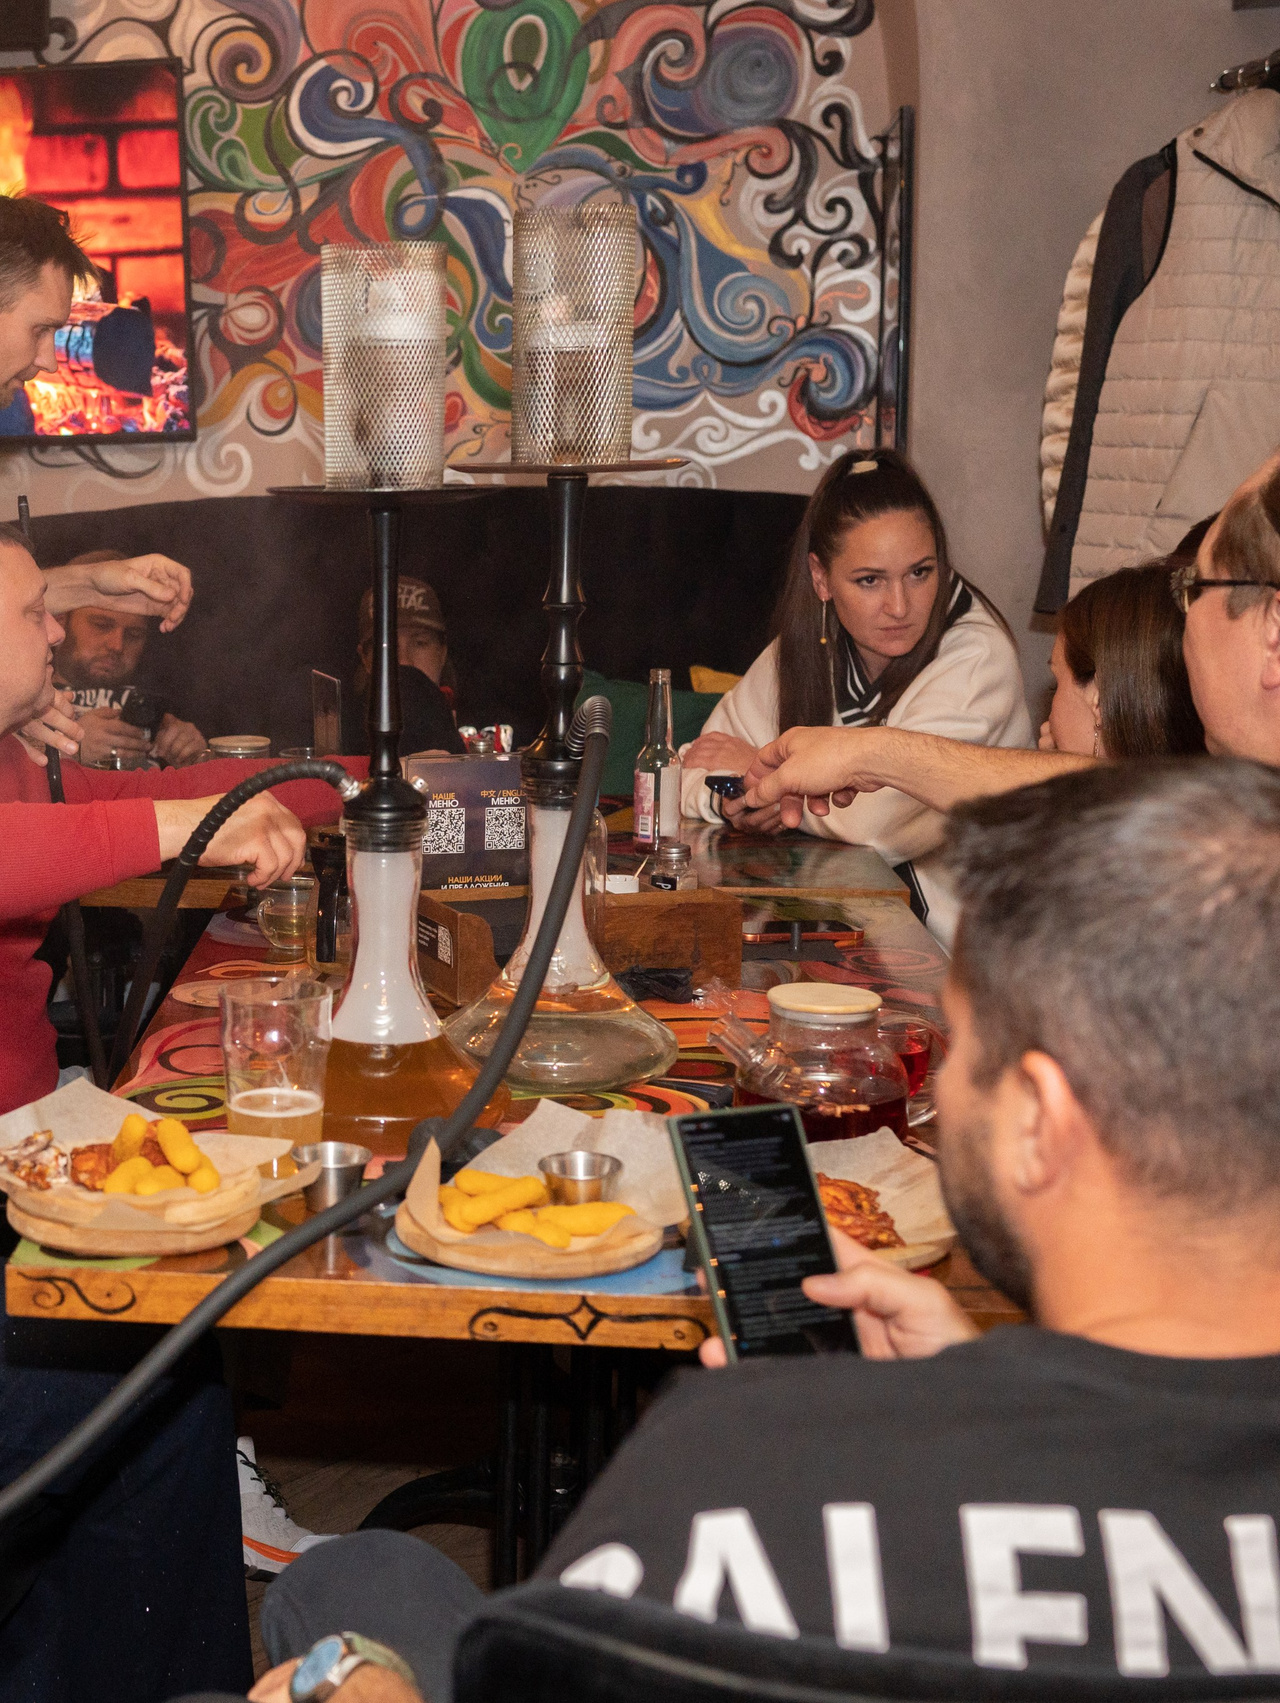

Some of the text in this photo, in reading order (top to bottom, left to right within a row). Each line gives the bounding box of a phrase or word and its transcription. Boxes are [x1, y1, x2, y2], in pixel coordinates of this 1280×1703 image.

[432, 792, 455, 800] НАШЕ
[428, 799, 459, 808] МЕНЮ
[491, 796, 520, 806] МЕНЮ
[448, 874, 502, 883] НАШИ АКЦИИ
